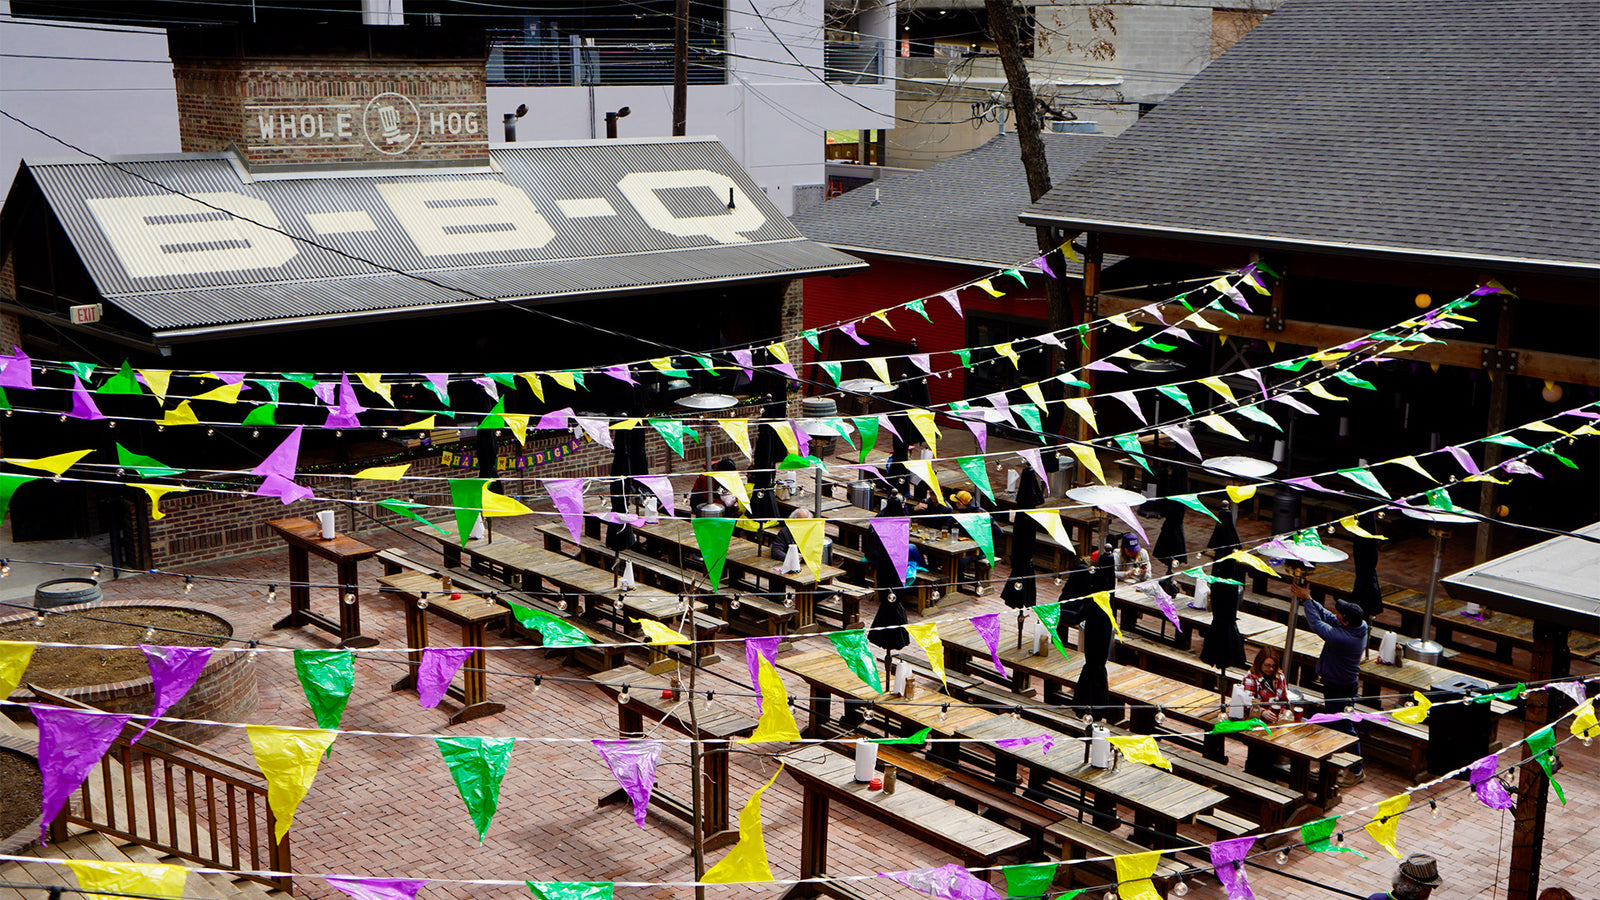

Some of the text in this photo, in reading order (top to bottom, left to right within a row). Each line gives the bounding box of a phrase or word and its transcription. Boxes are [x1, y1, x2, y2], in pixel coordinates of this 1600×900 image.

[258, 112, 479, 139] WHOLE HOG
[86, 169, 767, 279] B-B-Q
[77, 307, 96, 322] EXIT
[453, 441, 579, 469] HAP MARDI GRA
